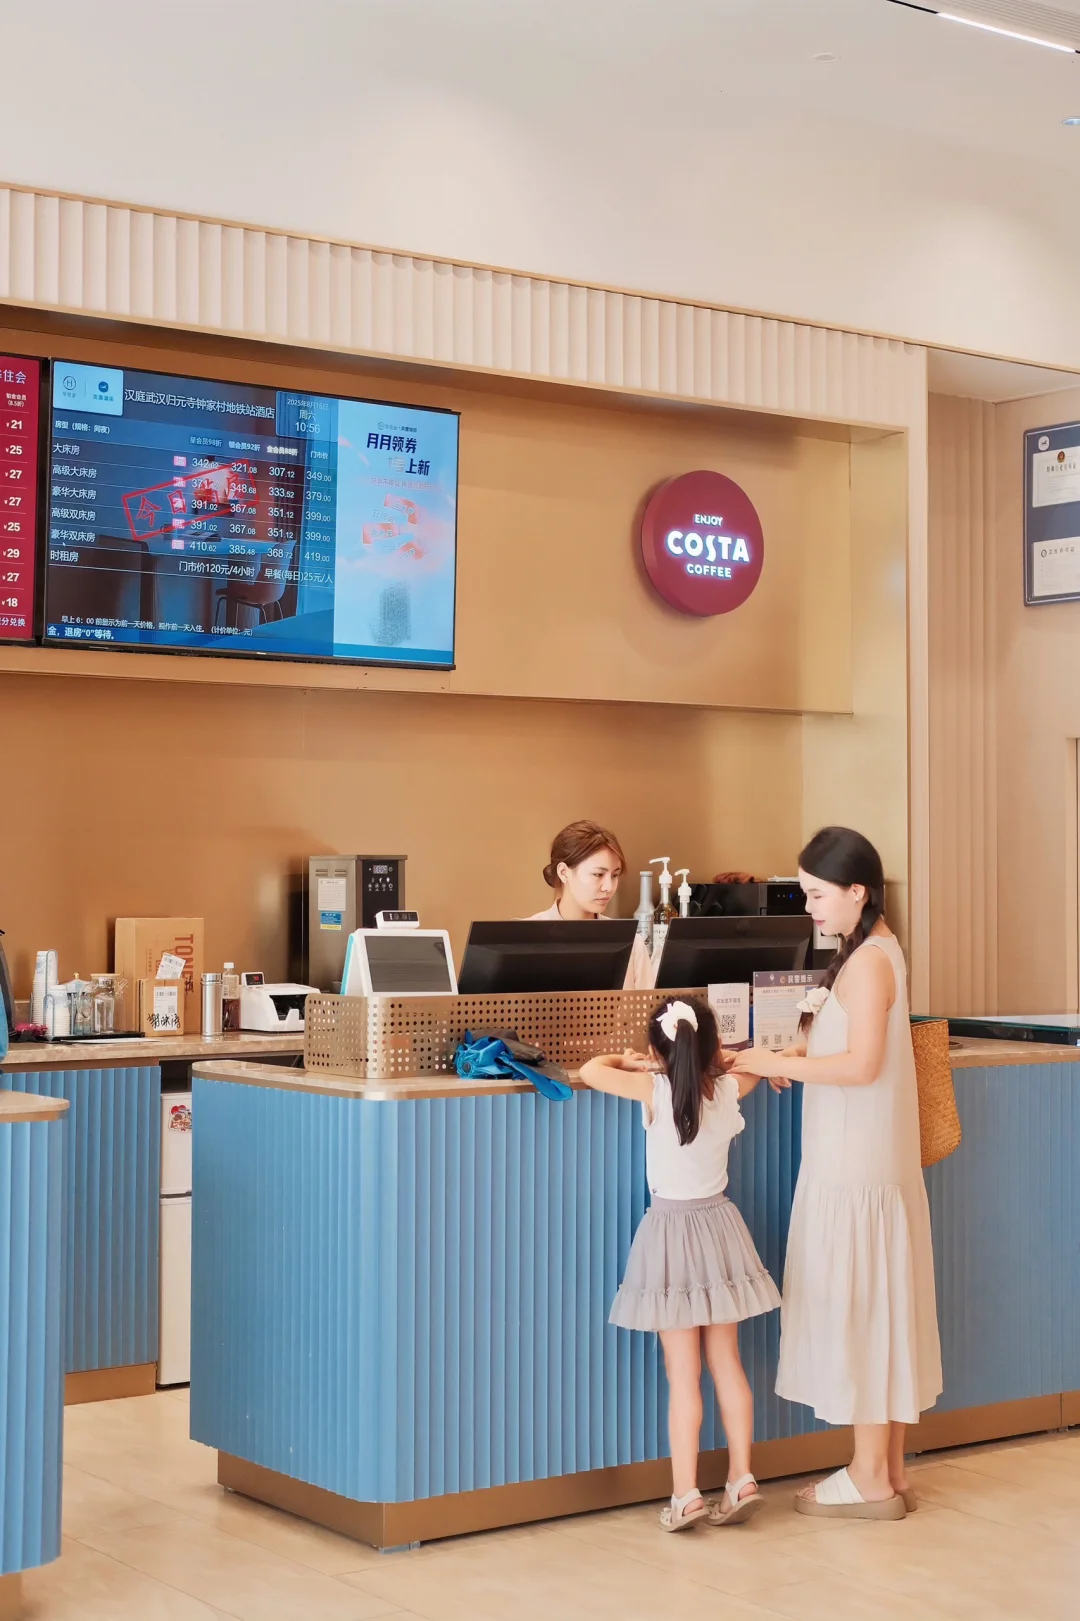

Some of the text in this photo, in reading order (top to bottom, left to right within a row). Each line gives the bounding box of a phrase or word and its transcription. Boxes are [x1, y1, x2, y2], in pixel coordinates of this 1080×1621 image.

[0, 369, 27, 384] 住会
[124, 388, 275, 419] 汉庭武汉归元寺钟家村地铁站酒店
[298, 409, 316, 420] 周六
[295, 422, 321, 434] 10:56
[53, 443, 80, 456] 大床房
[367, 432, 417, 454] 月月领券
[310, 450, 328, 459] 门市价
[52, 464, 97, 478] 高级大床房
[192, 457, 219, 469] 342.02
[231, 461, 258, 474] 321.08
[269, 466, 295, 479] 307.12
[306, 470, 332, 482] 349.00
[51, 485, 97, 500] 豪华大床房
[230, 482, 257, 494] 348.68
[268, 486, 295, 499] 333.52
[306, 490, 331, 503] 379.00
[51, 507, 96, 521] 高级双床房
[191, 499, 331, 522] 391.02 367.08 351.12 399.00
[694, 514, 723, 526] ENJOY
[51, 528, 96, 543] 豪华双床房
[190, 520, 218, 532] 391.02
[229, 523, 256, 535] 367.08
[267, 527, 294, 539] 351.12
[305, 531, 331, 543] 399.00
[190, 541, 217, 552] 410.62
[229, 544, 256, 556] 385.48
[267, 548, 293, 559] 368.72
[304, 552, 330, 563] 419.00
[667, 530, 750, 562] COSTA
[50, 551, 79, 563] 时租房
[179, 561, 255, 577] 门市价120元/4小时
[686, 563, 732, 578] COFFEE
